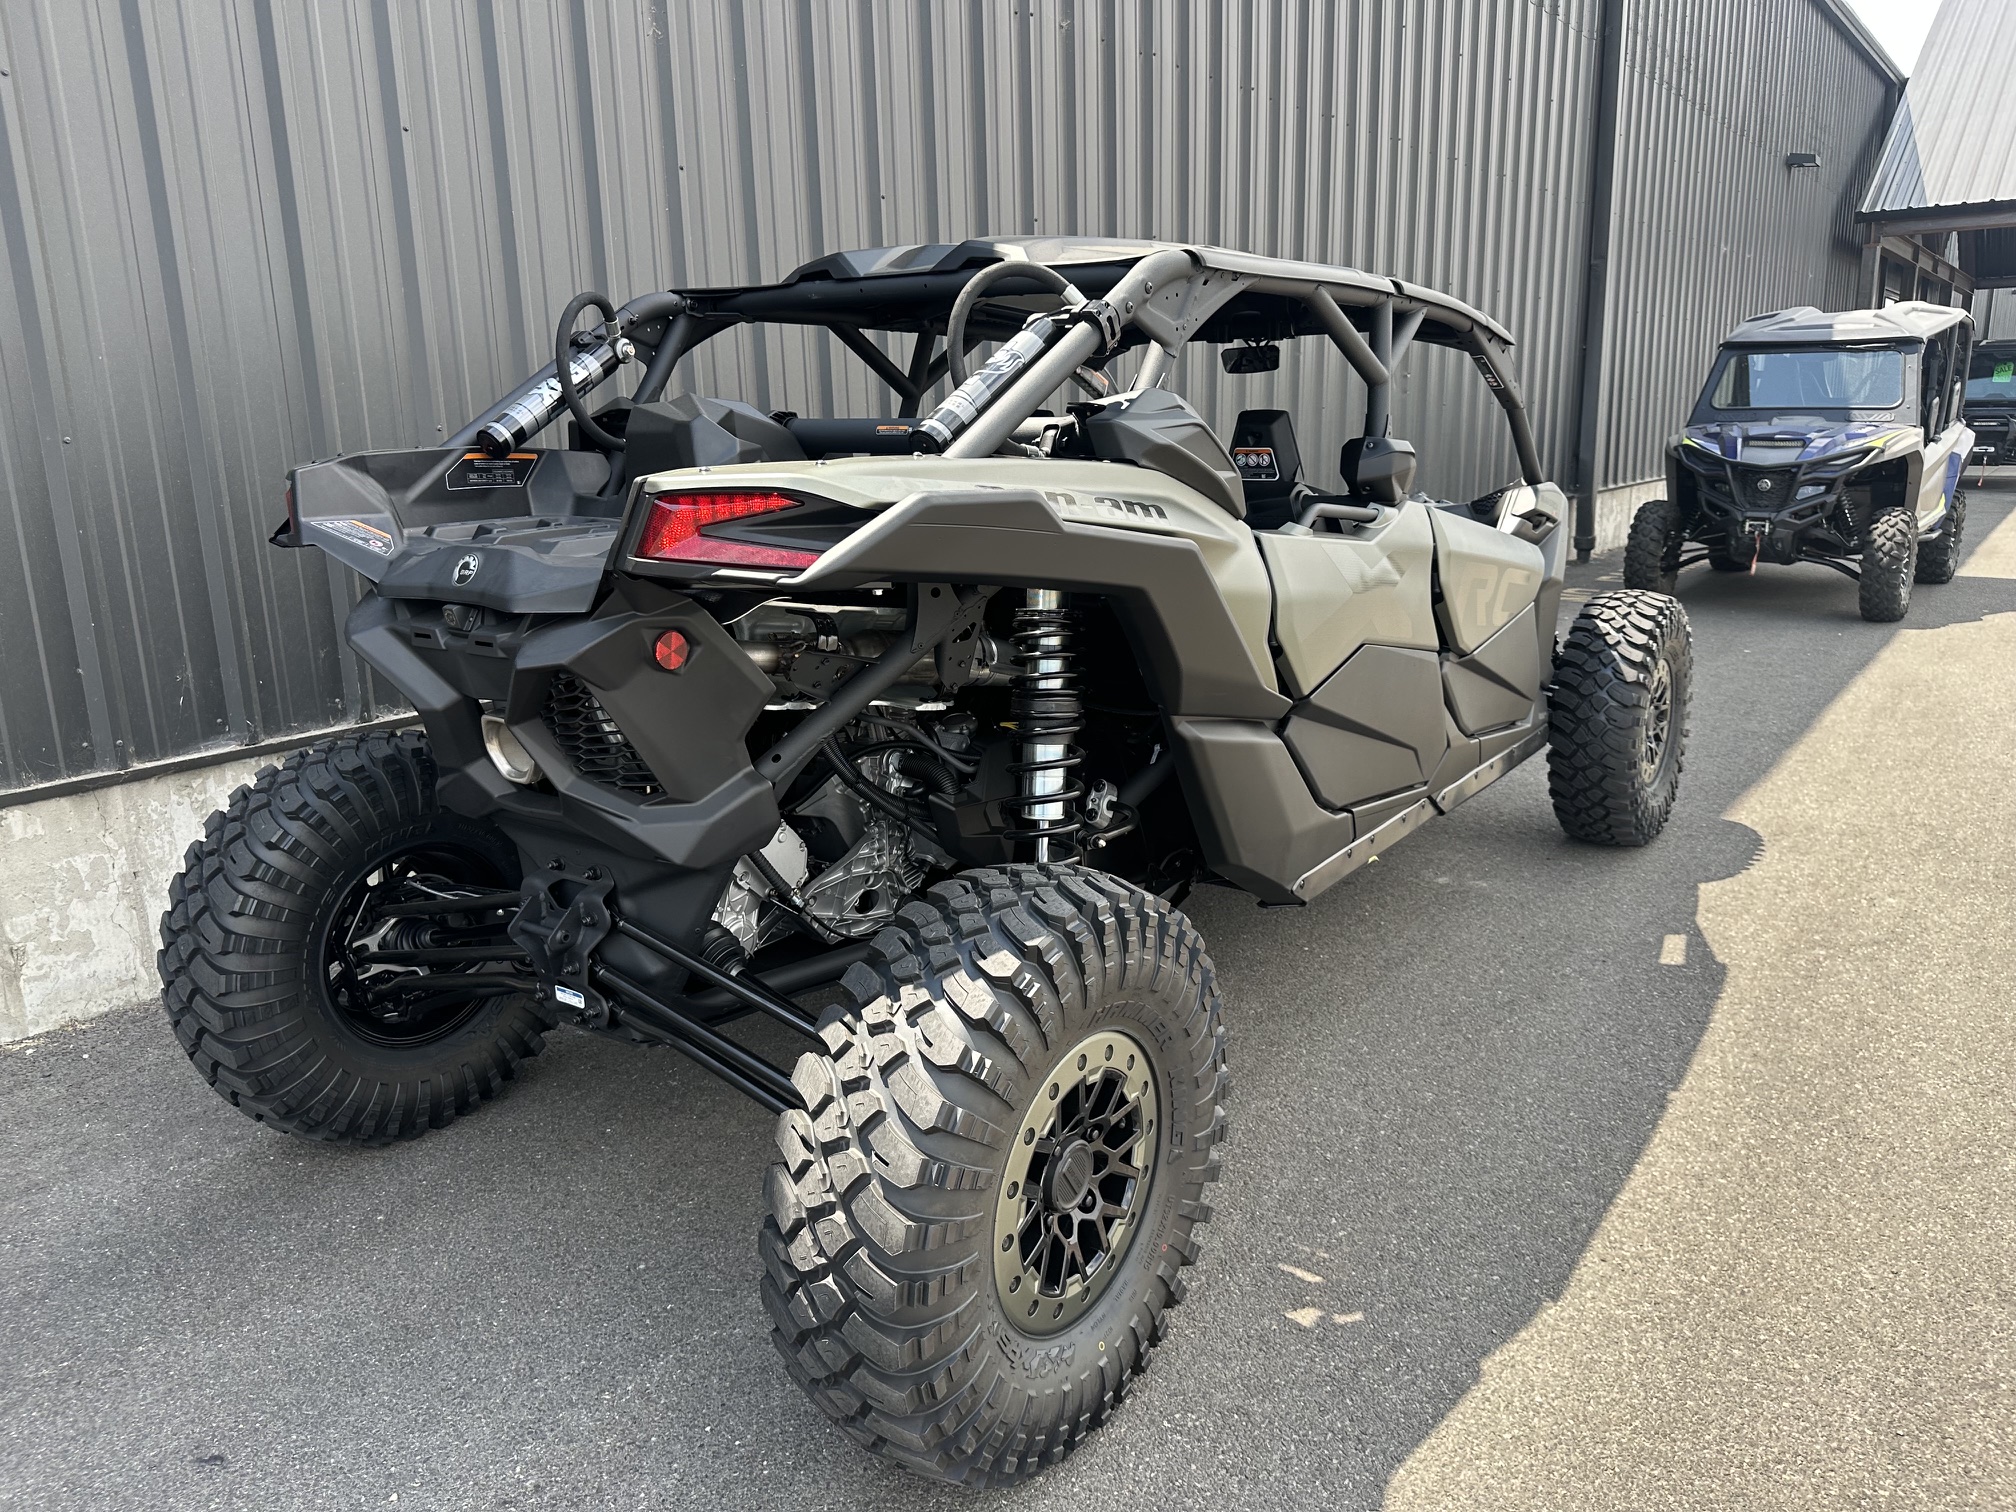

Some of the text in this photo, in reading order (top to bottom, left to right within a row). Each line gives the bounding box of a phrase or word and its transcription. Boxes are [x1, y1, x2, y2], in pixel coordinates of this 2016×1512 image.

[1995, 364, 2012, 375] SALE
[1086, 1000, 1187, 1146] HAMMER KING
